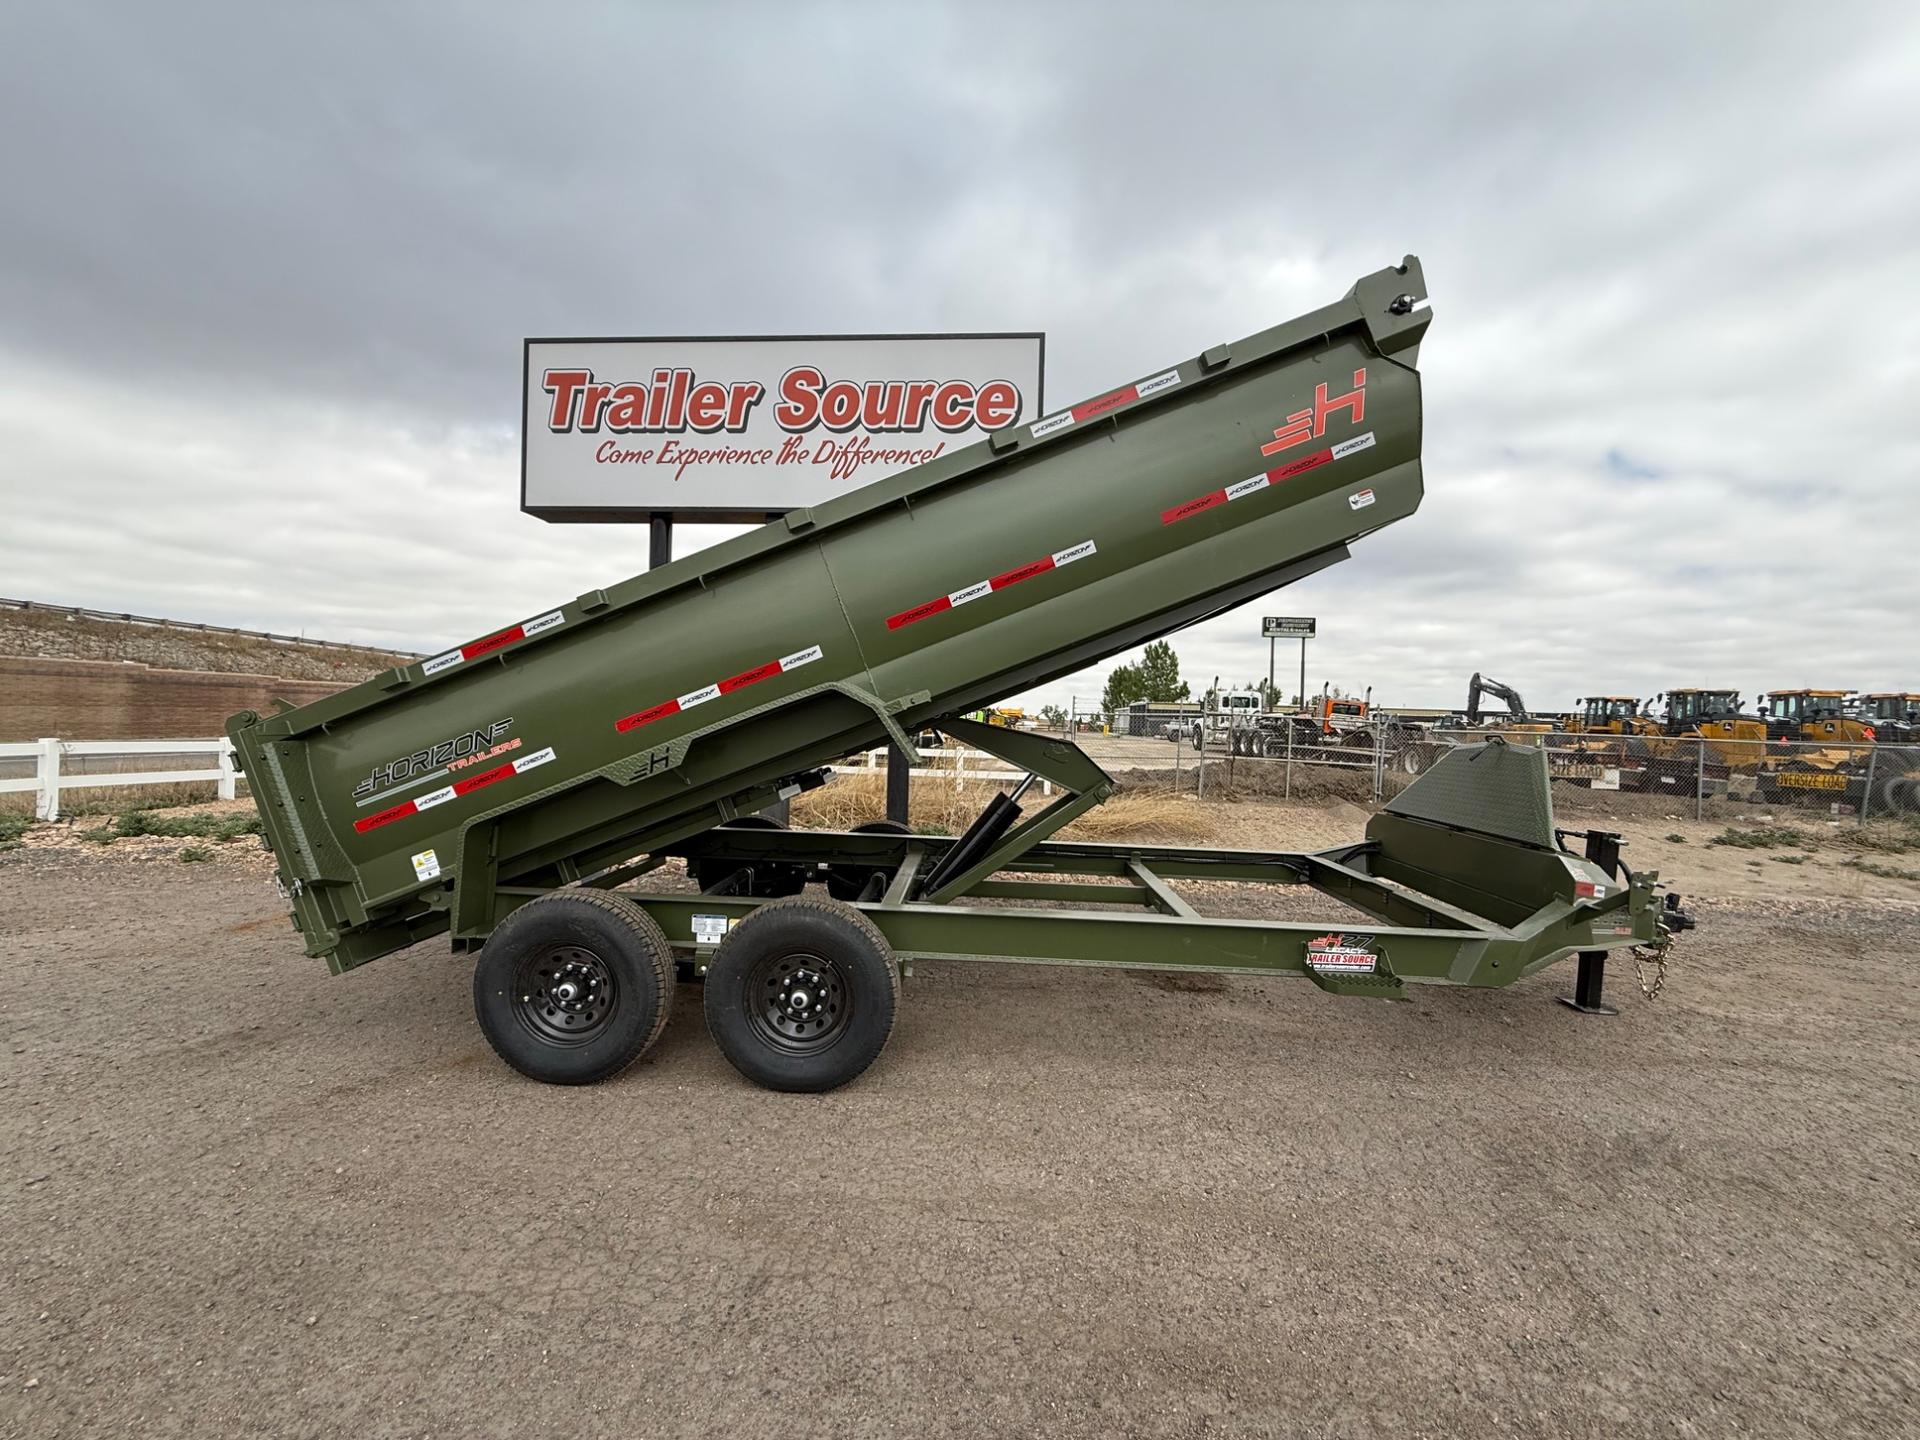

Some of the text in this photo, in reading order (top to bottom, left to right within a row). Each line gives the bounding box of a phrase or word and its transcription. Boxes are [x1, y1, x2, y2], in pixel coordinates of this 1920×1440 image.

[543, 366, 1021, 437] Trailer Source
[596, 435, 945, 481] Come Experience the Difference!
[370, 724, 494, 791] HORIZON
[448, 738, 522, 771] TRAILERS
[1777, 773, 1847, 789] OVERSIZE LOAD
[1309, 954, 1375, 964] RAILER SOURCE
